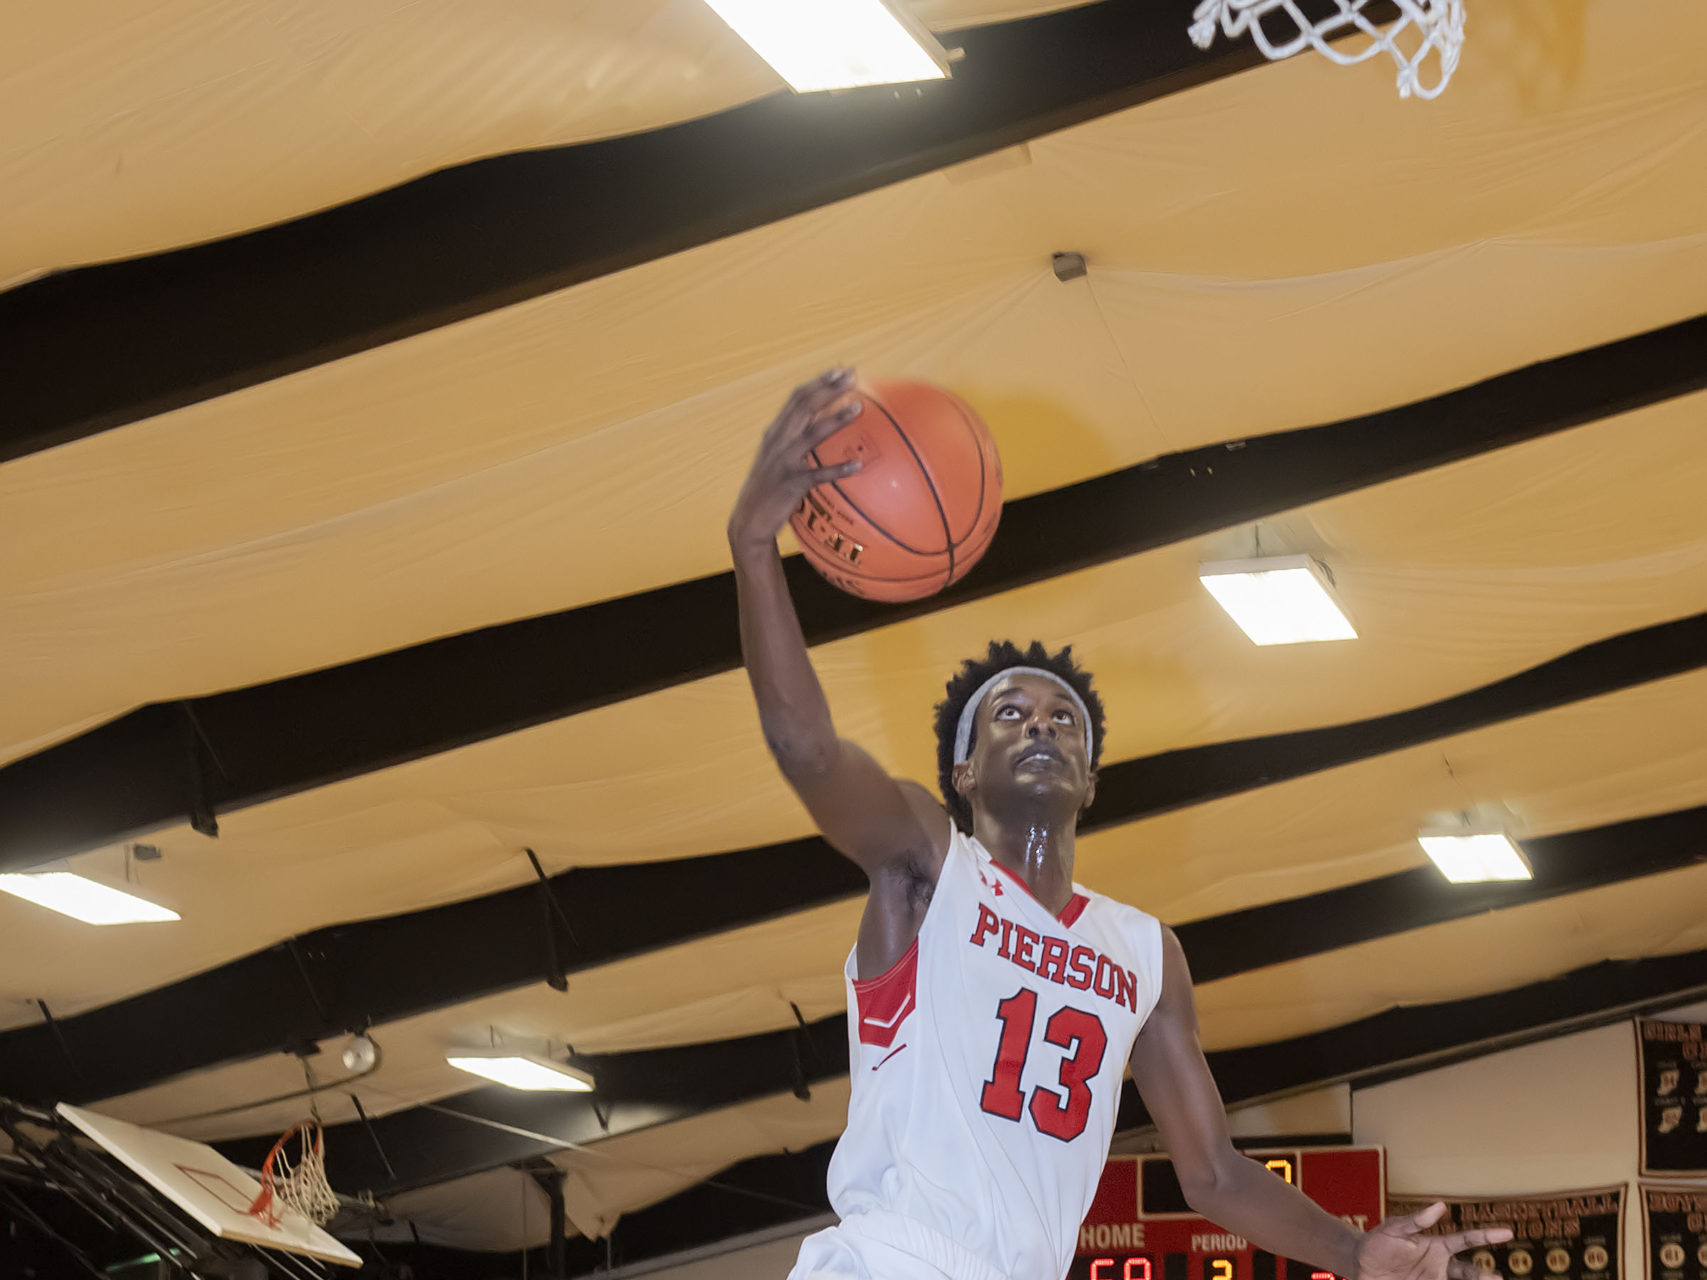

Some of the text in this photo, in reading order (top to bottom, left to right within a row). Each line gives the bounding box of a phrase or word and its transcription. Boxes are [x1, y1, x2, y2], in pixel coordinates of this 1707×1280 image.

[970, 901, 1138, 1014] PIERSON
[980, 987, 1108, 1143] 13
[1079, 1223, 1146, 1249] HOME
[1191, 1234, 1248, 1251] PERIOD
